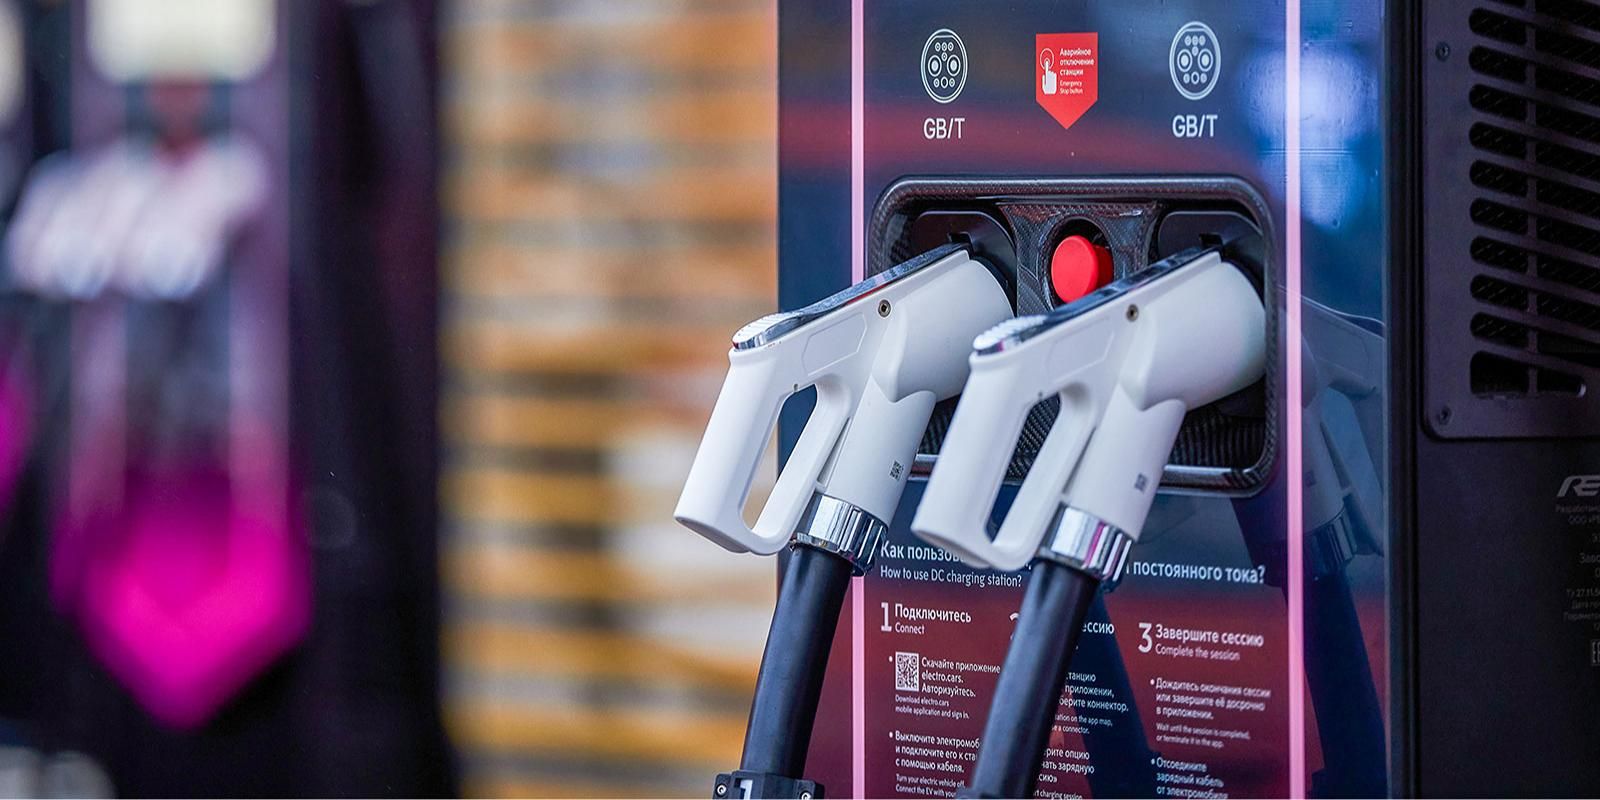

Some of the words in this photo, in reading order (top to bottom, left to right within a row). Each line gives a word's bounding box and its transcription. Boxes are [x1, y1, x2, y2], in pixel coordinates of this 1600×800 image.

[1060, 48, 1091, 57] Аварийное
[923, 118, 965, 139] GB/T
[1172, 115, 1218, 137] GB/T
[880, 541, 904, 559] Как
[907, 546, 964, 562] пользов
[880, 565, 900, 579] How
[903, 566, 911, 579] to
[913, 570, 929, 581] use
[931, 569, 944, 582] DC
[946, 570, 985, 588] charging
[987, 574, 1022, 588] station?
[1133, 562, 1222, 581] постоянного
[1225, 565, 1265, 584] тока?
[880, 602, 892, 632] 1
[895, 603, 972, 623] Подключитесь
[895, 623, 925, 635] Connect
[1138, 622, 1152, 653] 3
[1155, 624, 1219, 644] Завершите
[1221, 632, 1264, 647] сессию
[1155, 643, 1194, 658] Complete
[1195, 647, 1208, 659] the
[1210, 650, 1240, 661] session
[922, 657, 954, 670] Скачайте
[955, 661, 1000, 674] приложение
[922, 670, 963, 683] electro.cars.
[1066, 672, 1096, 682] танцию
[922, 683, 976, 697] Авторизуйтесь.
[1065, 685, 1114, 698] приложении,
[1156, 677, 1199, 691] Дождитесь
[1200, 684, 1241, 694] окончания
[1243, 687, 1271, 698] сессии
[895, 694, 920, 704] Download
[1059, 695, 1085, 708] берите
[1087, 700, 1129, 713] коннектор.
[1156, 694, 1170, 702] или
[1172, 695, 1213, 706] завершите
[1226, 700, 1265, 711] досрочно
[895, 706, 912, 714] mobile
[913, 707, 940, 717] application
[941, 709, 951, 717] and
[952, 710, 961, 719] sign
[1055, 714, 1070, 722] ation
[1079, 715, 1087, 723] the
[1088, 717, 1098, 725] app
[895, 730, 935, 744] Выключите
[936, 738, 980, 749] электромоб
[901, 746, 943, 758] подключите
[945, 751, 957, 760] его
[1044, 748, 1063, 758] рите
[1065, 750, 1090, 760] опцию
[895, 758, 900, 766] с
[901, 758, 936, 770] помощью
[1058, 762, 1095, 775] зарядную
[1156, 757, 1207, 772] Отсоедините
[896, 774, 907, 782] Turn
[908, 775, 919, 784] your
[920, 775, 938, 786] electric
[939, 779, 956, 787] vehicle
[1038, 773, 1057, 783] сию»
[1156, 773, 1194, 784] зарядный
[1195, 774, 1224, 788] кабель
[895, 784, 916, 793] Connect
[917, 786, 925, 794] the
[1157, 786, 1165, 794] от
